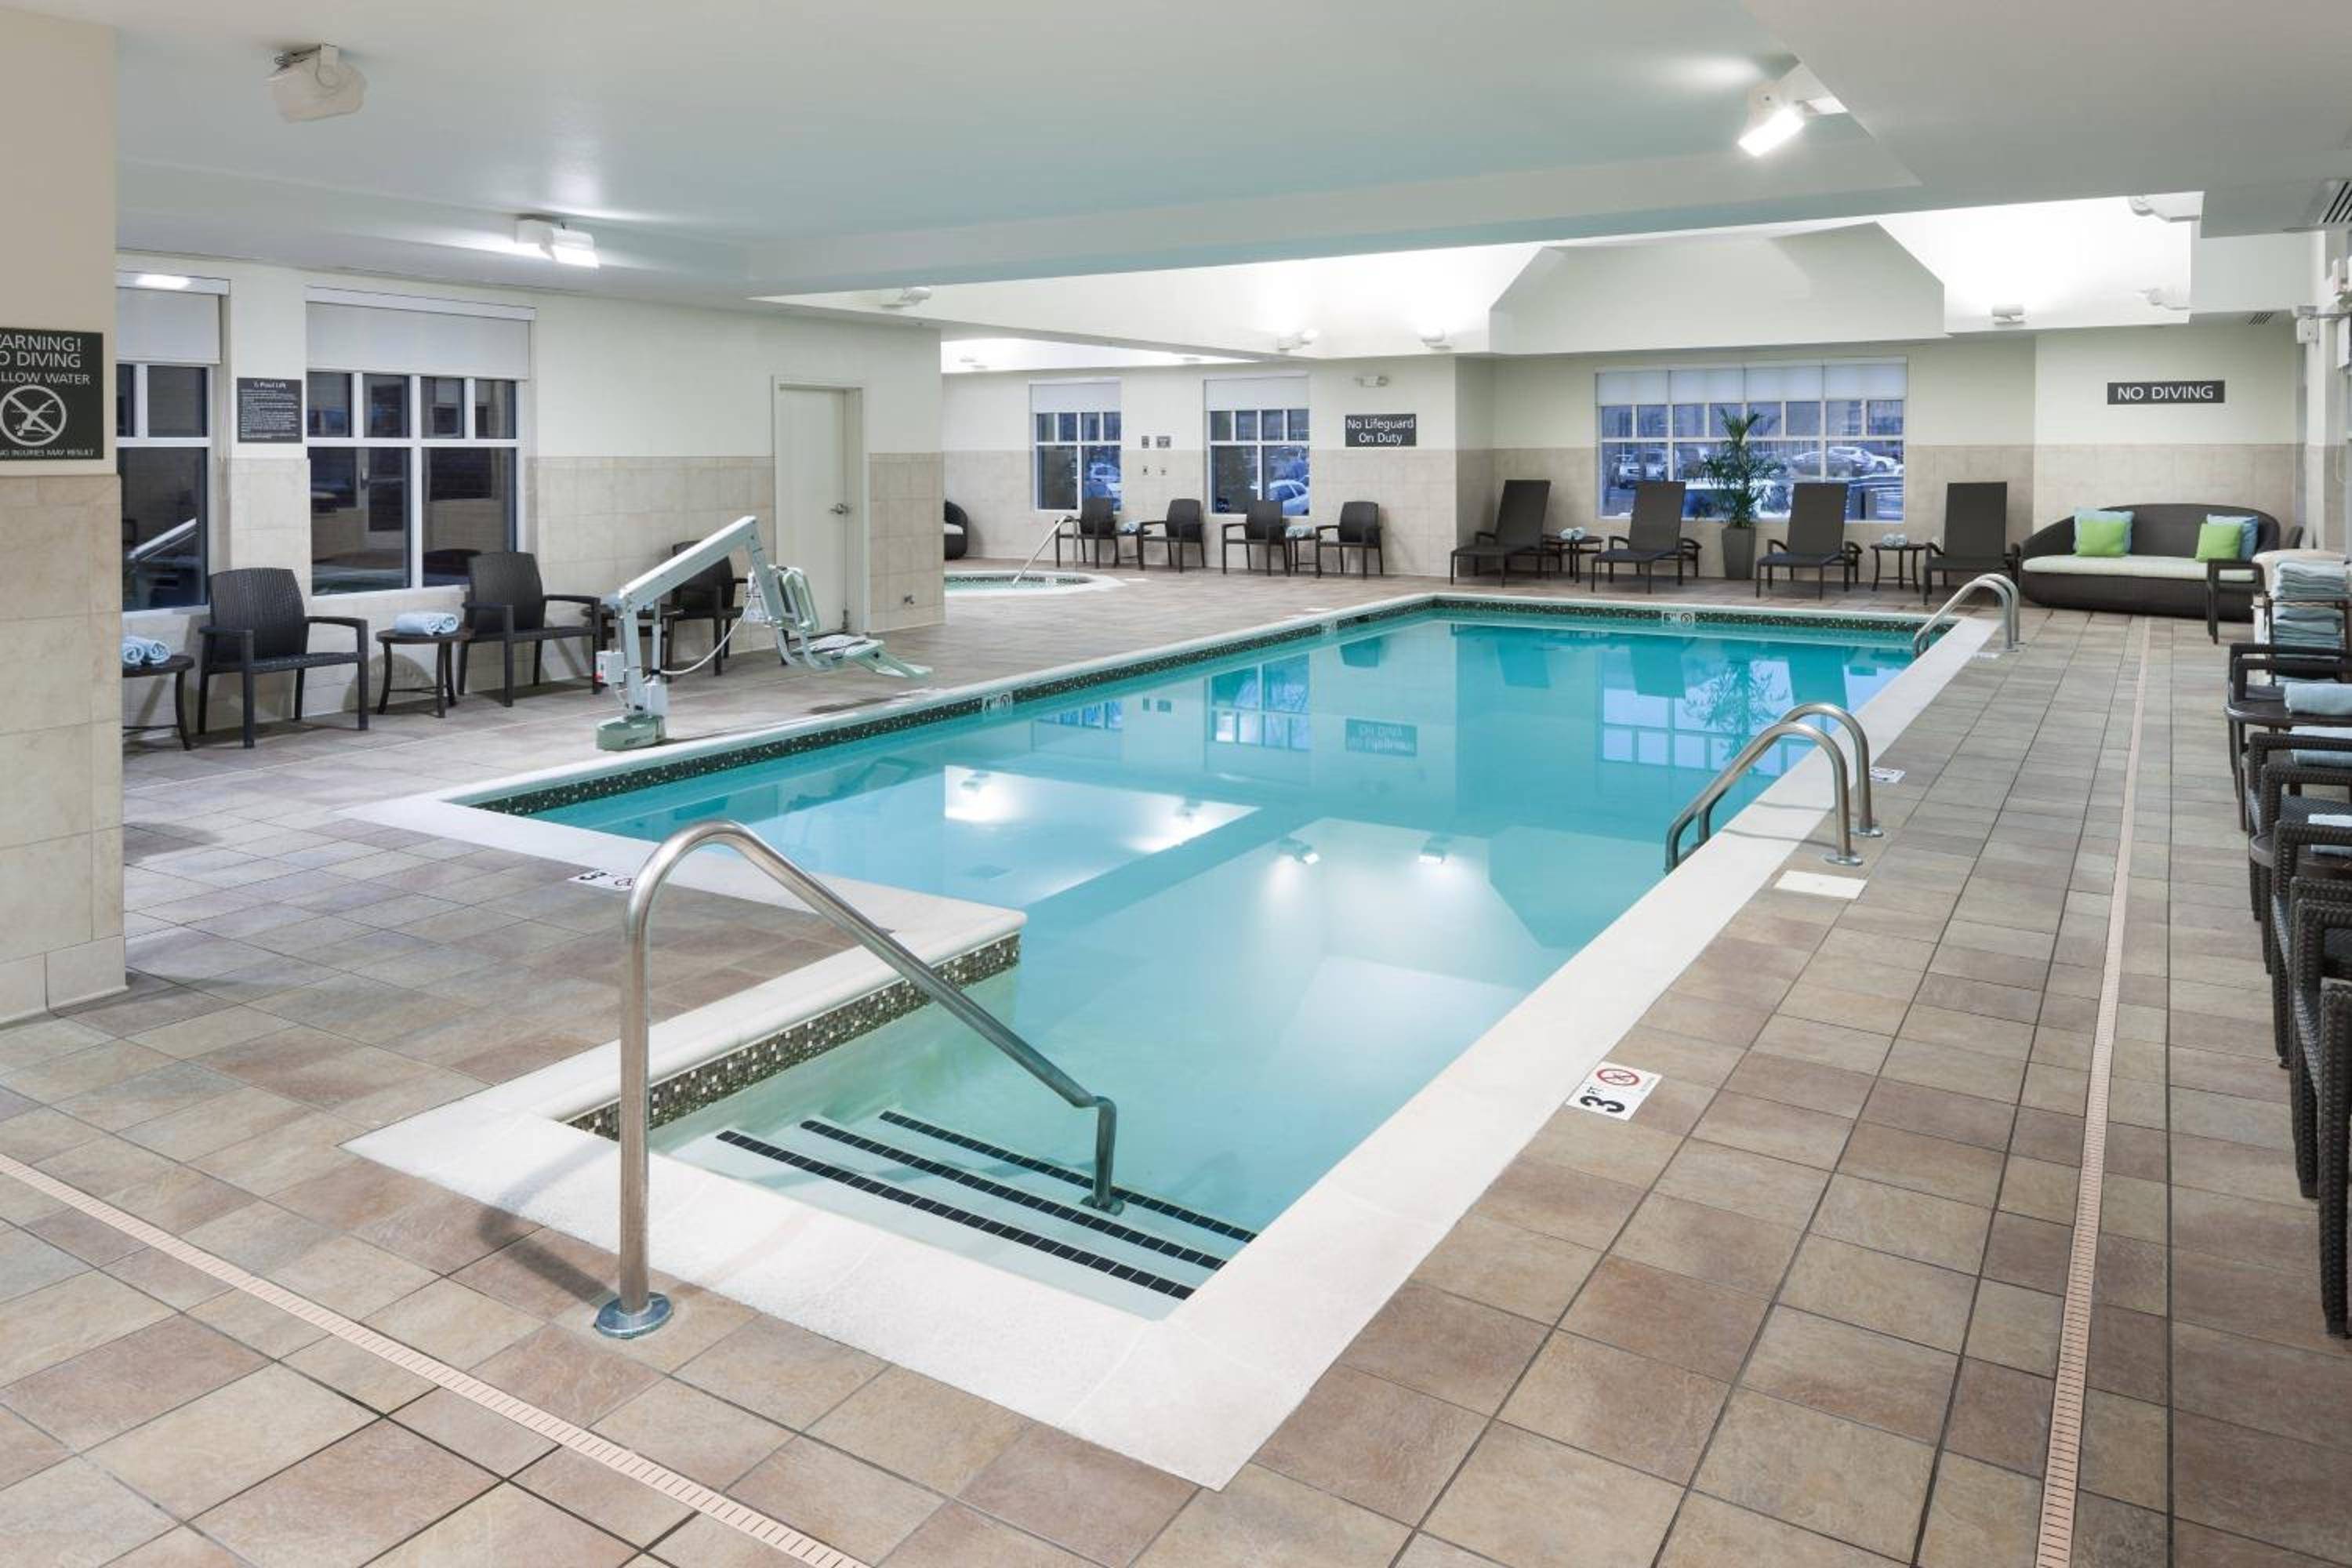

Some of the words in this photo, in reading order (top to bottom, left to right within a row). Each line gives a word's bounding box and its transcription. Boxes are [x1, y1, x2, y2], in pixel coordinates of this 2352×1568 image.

[0, 333, 82, 352] ARNING!
[16, 350, 82, 368] DIVING
[0, 371, 41, 383] LLOW
[45, 372, 91, 385] WATER
[2118, 386, 2144, 400] NO
[2151, 385, 2214, 399] DIVING
[1347, 419, 1362, 430] No
[1365, 417, 1414, 432] Lifeguard
[1359, 432, 1374, 443] On
[1377, 432, 1403, 446] Duty
[1580, 1095, 1625, 1113] 3
